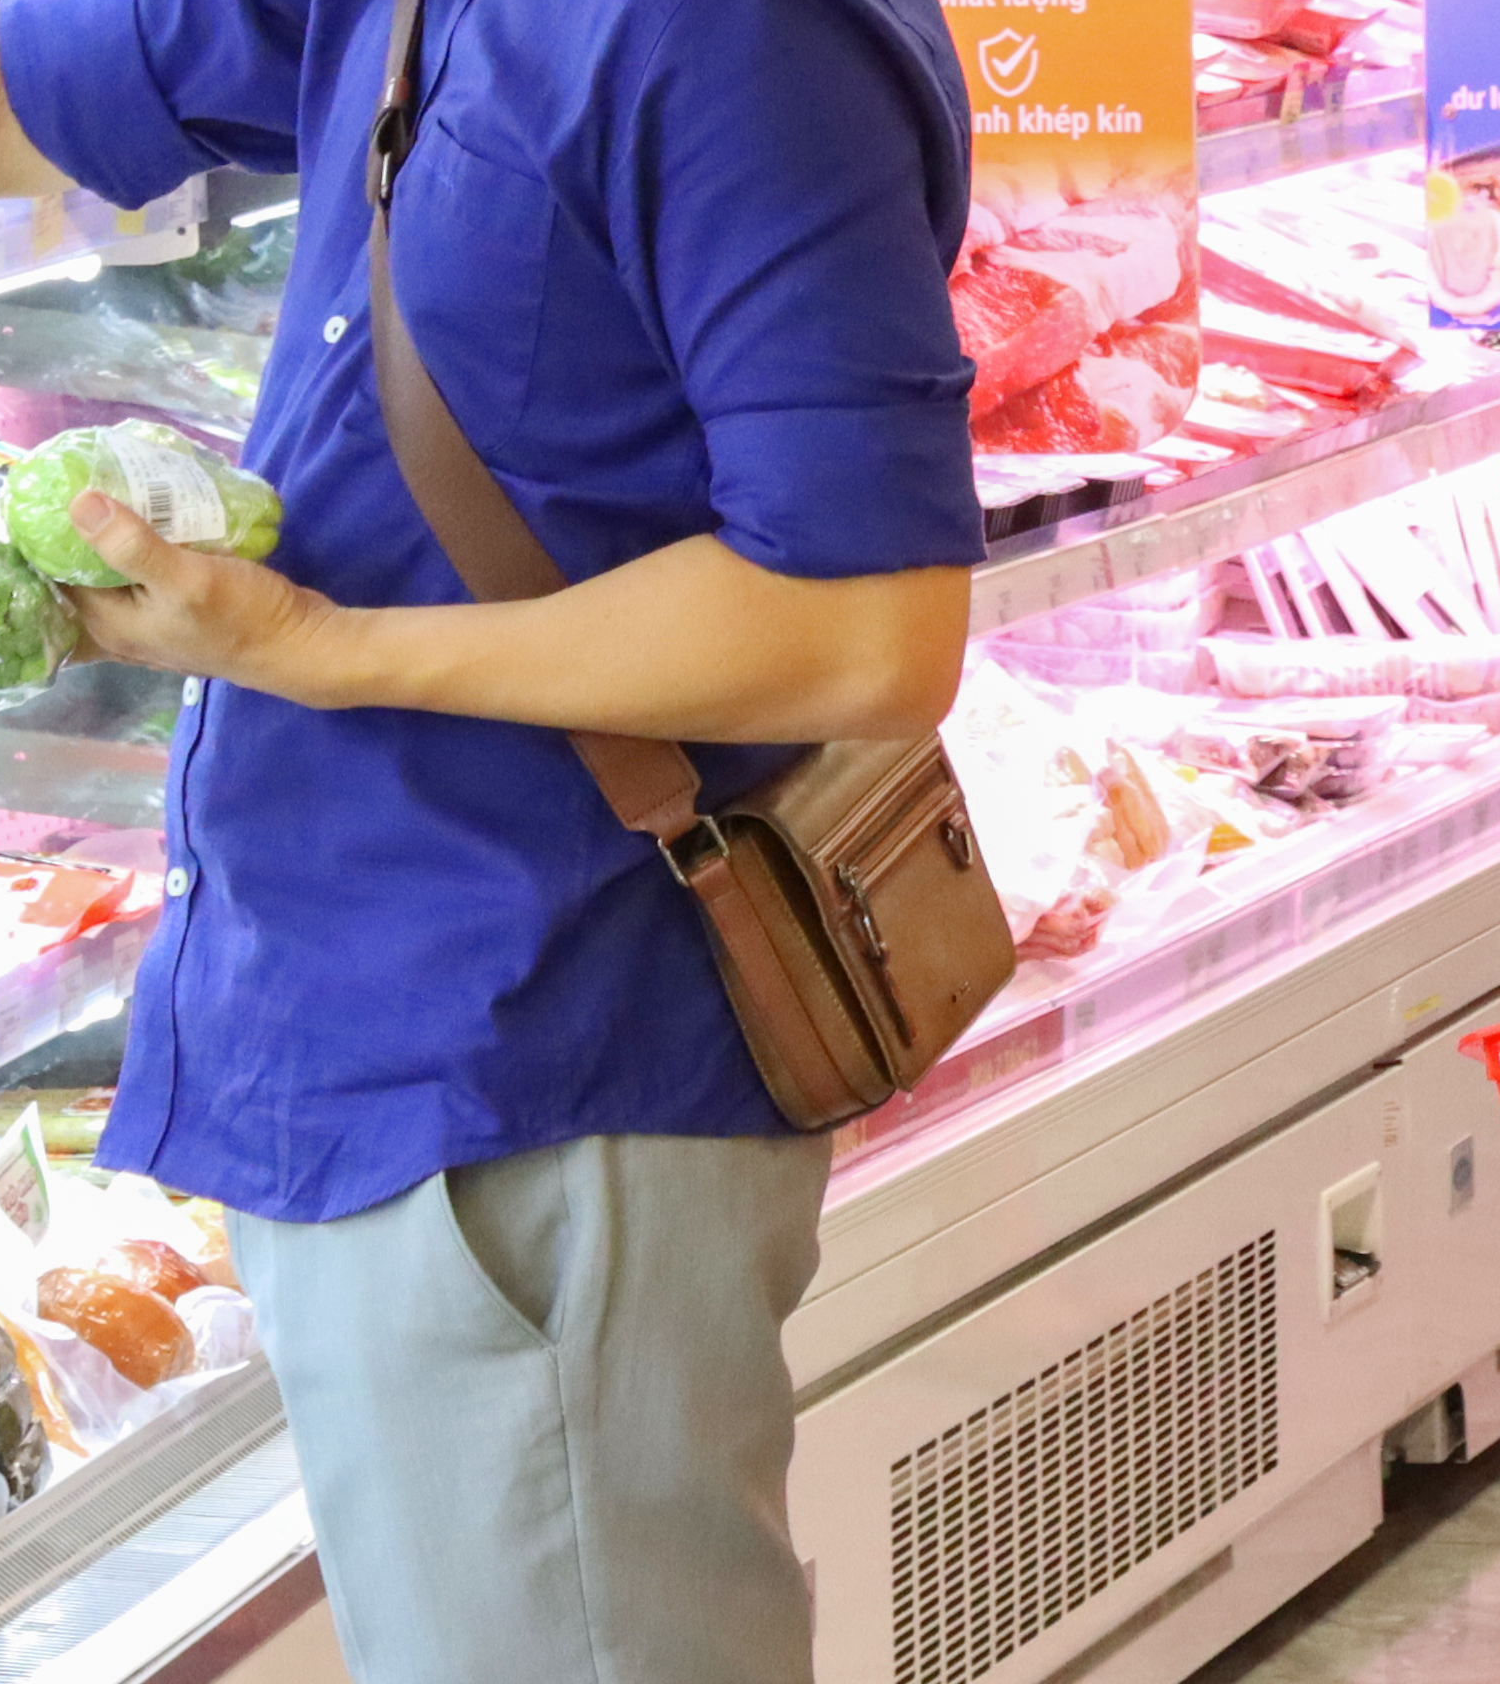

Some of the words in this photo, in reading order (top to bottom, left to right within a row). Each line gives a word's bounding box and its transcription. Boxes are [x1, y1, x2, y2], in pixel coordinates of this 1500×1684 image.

[1451, 84, 1487, 111] dư
[1018, 103, 1090, 141] khép
[1097, 103, 1143, 133] kín
